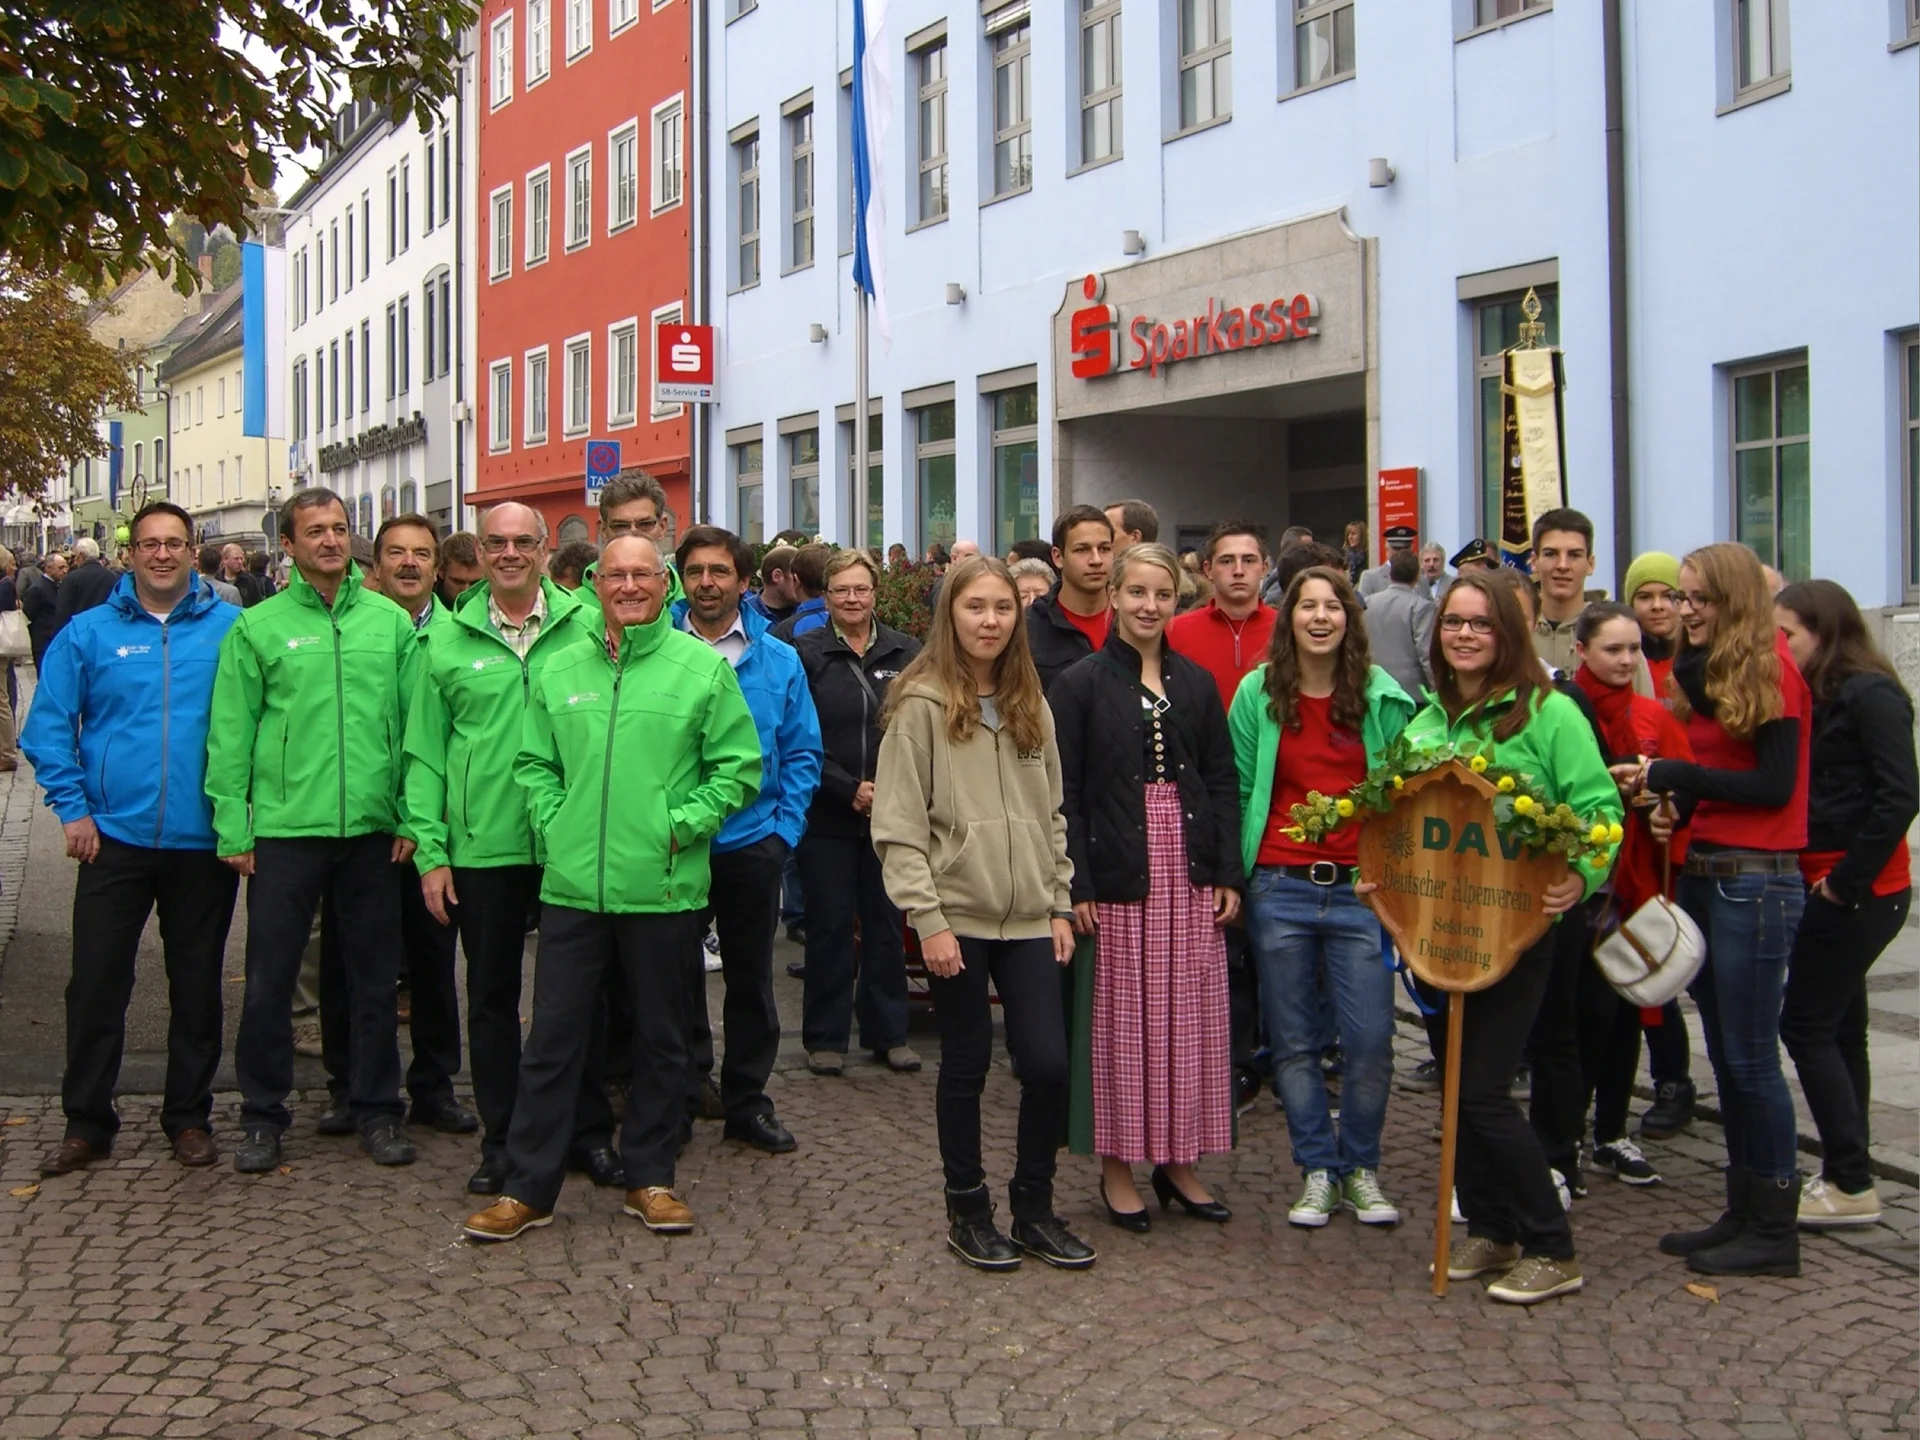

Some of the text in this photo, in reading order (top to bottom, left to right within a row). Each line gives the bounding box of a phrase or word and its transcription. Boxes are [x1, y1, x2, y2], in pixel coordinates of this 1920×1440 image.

[1130, 293, 1315, 378] Sparkasse
[661, 387, 698, 397] SB-Service
[1423, 816, 1524, 861] DAV
[1382, 864, 1532, 913] Deutscher Alpenverein
[1432, 917, 1484, 938] Sektion
[1419, 938, 1492, 971] Dingolfing
